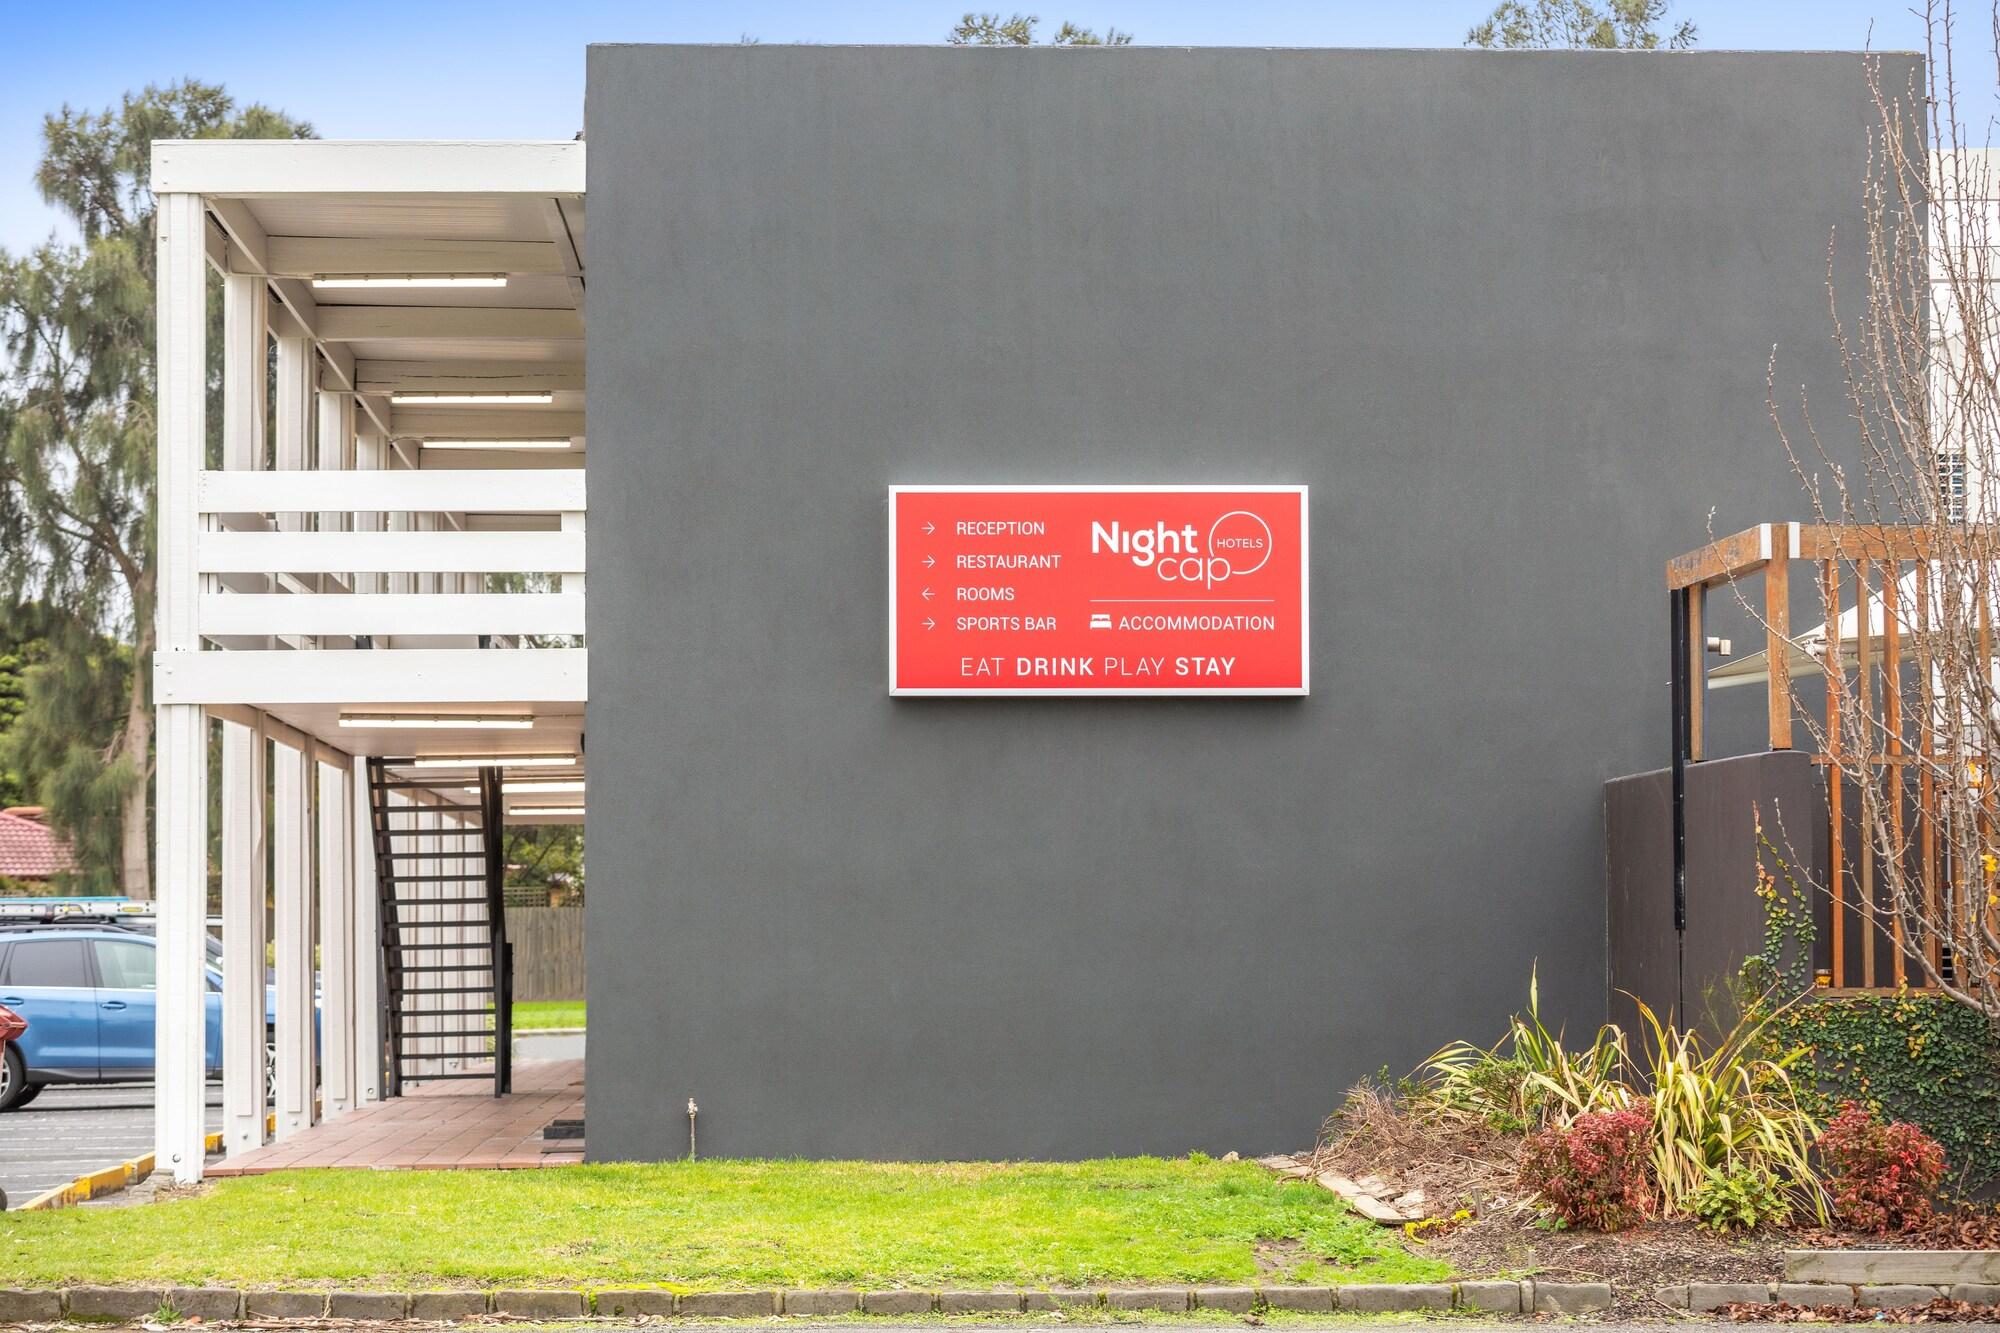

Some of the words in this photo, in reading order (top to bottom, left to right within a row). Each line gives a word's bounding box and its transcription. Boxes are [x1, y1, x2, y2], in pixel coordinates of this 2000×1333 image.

[956, 521, 1045, 535] RECEPTION
[1091, 520, 1199, 567] Night
[1216, 538, 1264, 549] HOTELS
[956, 554, 1062, 568] RESTAURANT
[1156, 557, 1231, 590] cap
[956, 587, 1015, 601] ROOMS
[956, 616, 1021, 631] SPORTS
[1024, 616, 1057, 631] BAR
[1118, 615, 1275, 631] ACCOMMODATION
[961, 657, 1005, 676] EAT
[1016, 657, 1094, 676] DRINK
[1104, 657, 1165, 676] PLAY
[1175, 656, 1236, 676] STAY
